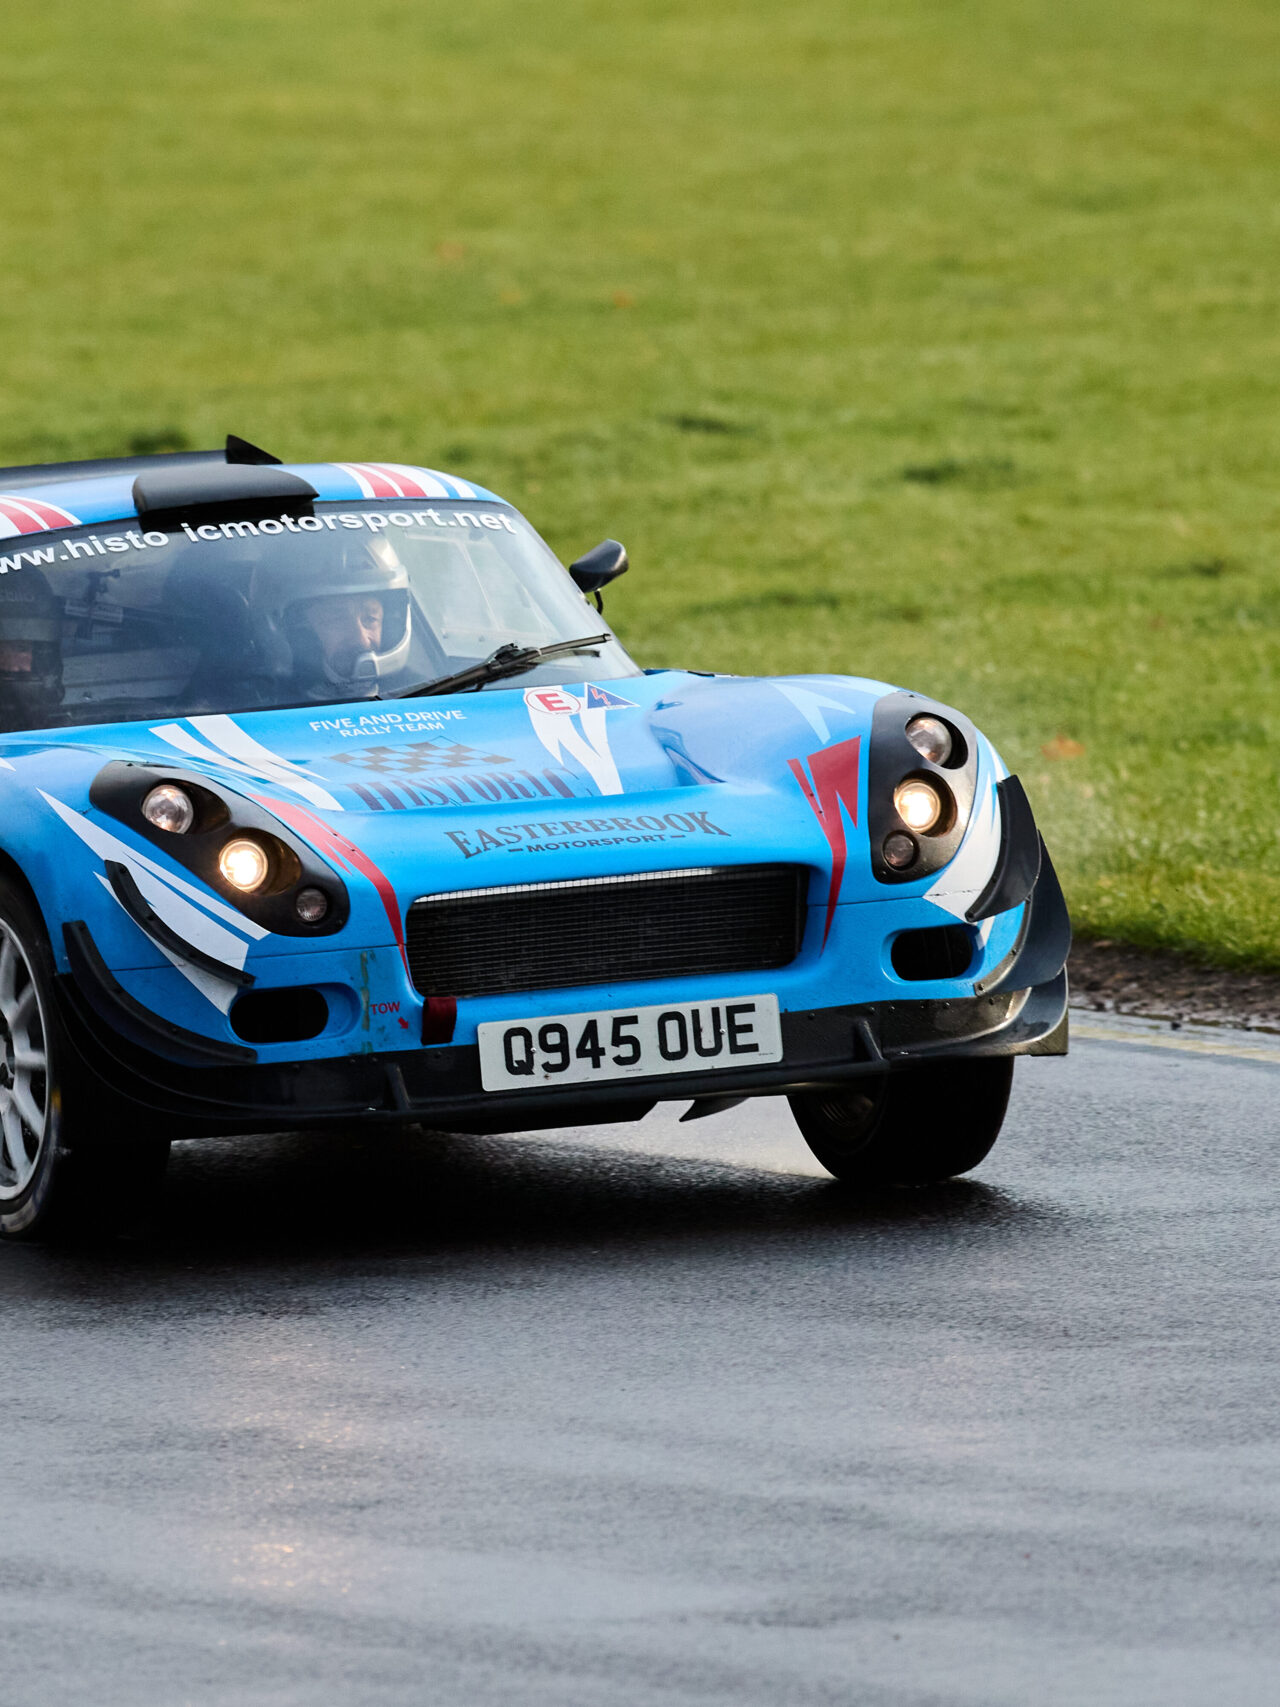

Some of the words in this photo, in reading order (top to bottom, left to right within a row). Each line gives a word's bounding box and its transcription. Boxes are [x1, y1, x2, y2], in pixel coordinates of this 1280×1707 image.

[535, 693, 572, 711] E
[309, 717, 356, 731] FIVE
[359, 713, 403, 727] AND
[404, 710, 468, 723] DRIVE
[340, 725, 392, 737] RALLY
[394, 722, 445, 733] TEAM
[343, 767, 593, 811] HISTORIC
[444, 811, 732, 859] EASTERBROOK
[527, 834, 666, 853] MOTORSPORT
[371, 1001, 400, 1015] TOW
[503, 1015, 642, 1076] Q945
[657, 1003, 760, 1061] OUE
